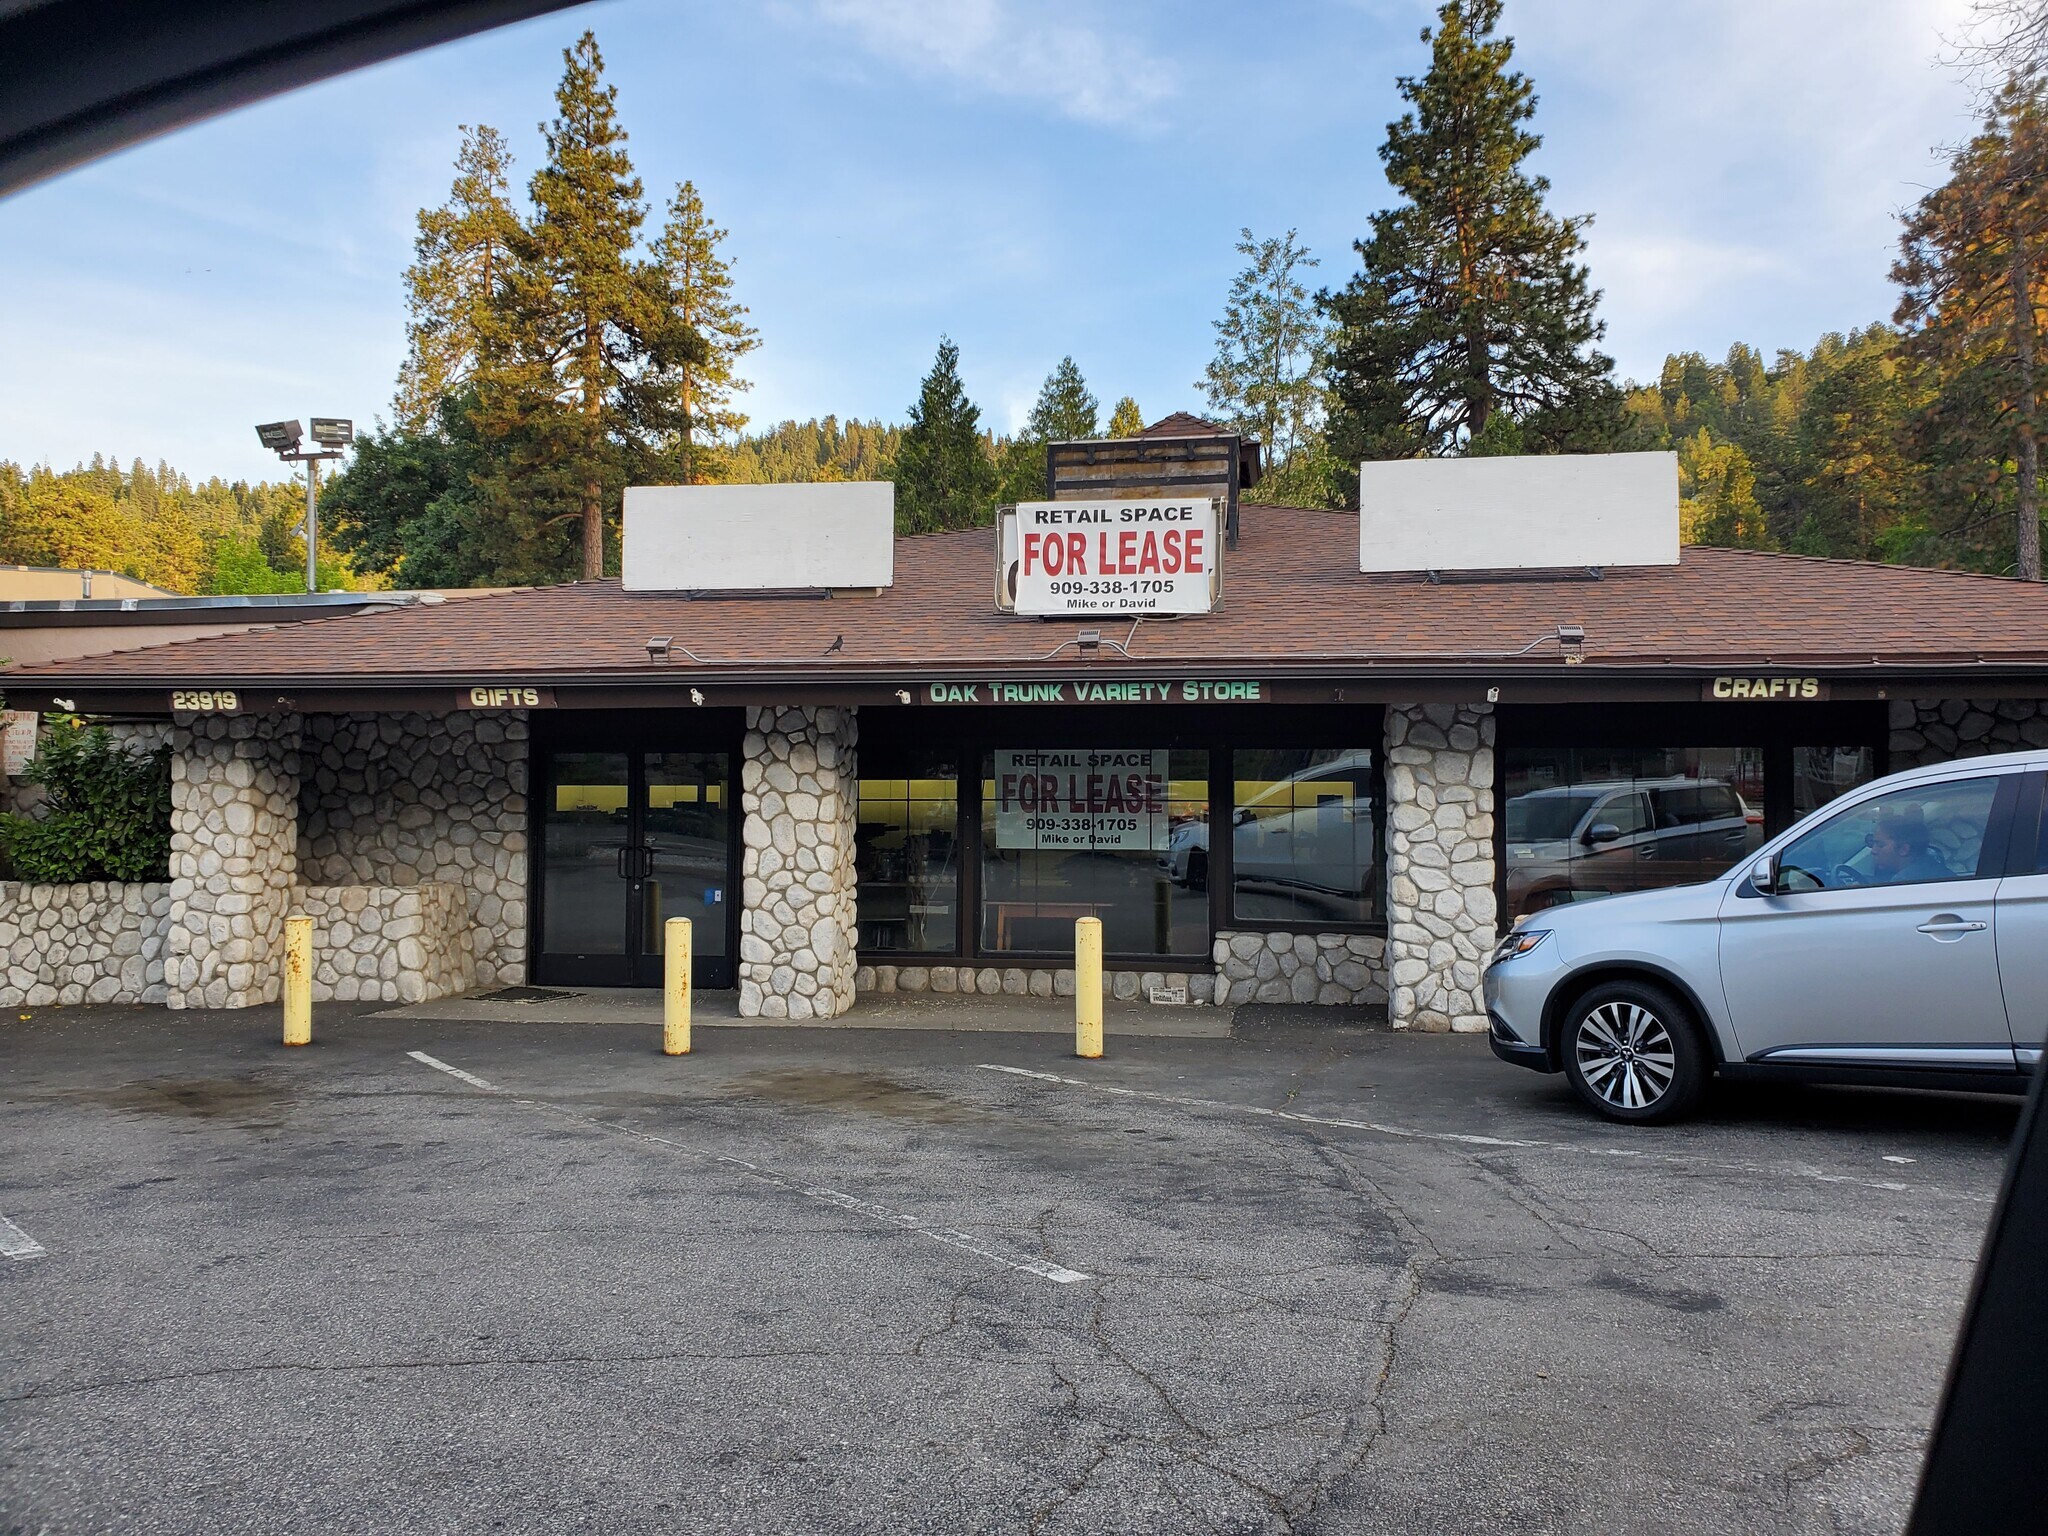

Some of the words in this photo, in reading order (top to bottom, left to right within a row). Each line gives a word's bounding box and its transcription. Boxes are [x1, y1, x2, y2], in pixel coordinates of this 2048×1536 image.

[1035, 509, 1112, 524] RETAIL
[1120, 506, 1193, 523] SPACE
[1024, 532, 1087, 576] FOR
[1098, 529, 1204, 575] LEASE
[1050, 580, 1174, 595] 909-338-1705
[1066, 599, 1098, 609] Mike
[1101, 601, 1115, 609] or
[1119, 598, 1156, 609] David
[470, 687, 539, 707] GIFTS
[930, 683, 978, 703] OAK
[988, 682, 1064, 702] TRUNK
[1072, 681, 1172, 702] VARIETY
[1182, 680, 1261, 701] STORE
[1713, 676, 1819, 699] CRAFTS
[172, 691, 237, 711] 23919
[1011, 754, 1081, 767] RETAIL
[1087, 754, 1152, 767] SPACE
[1002, 773, 1059, 814] FOR
[1069, 773, 1163, 814] LEASE
[1026, 818, 1137, 831] 909-338-1705
[1041, 833, 1070, 844] Mike
[1072, 836, 1085, 844] or
[1088, 833, 1121, 844] David
